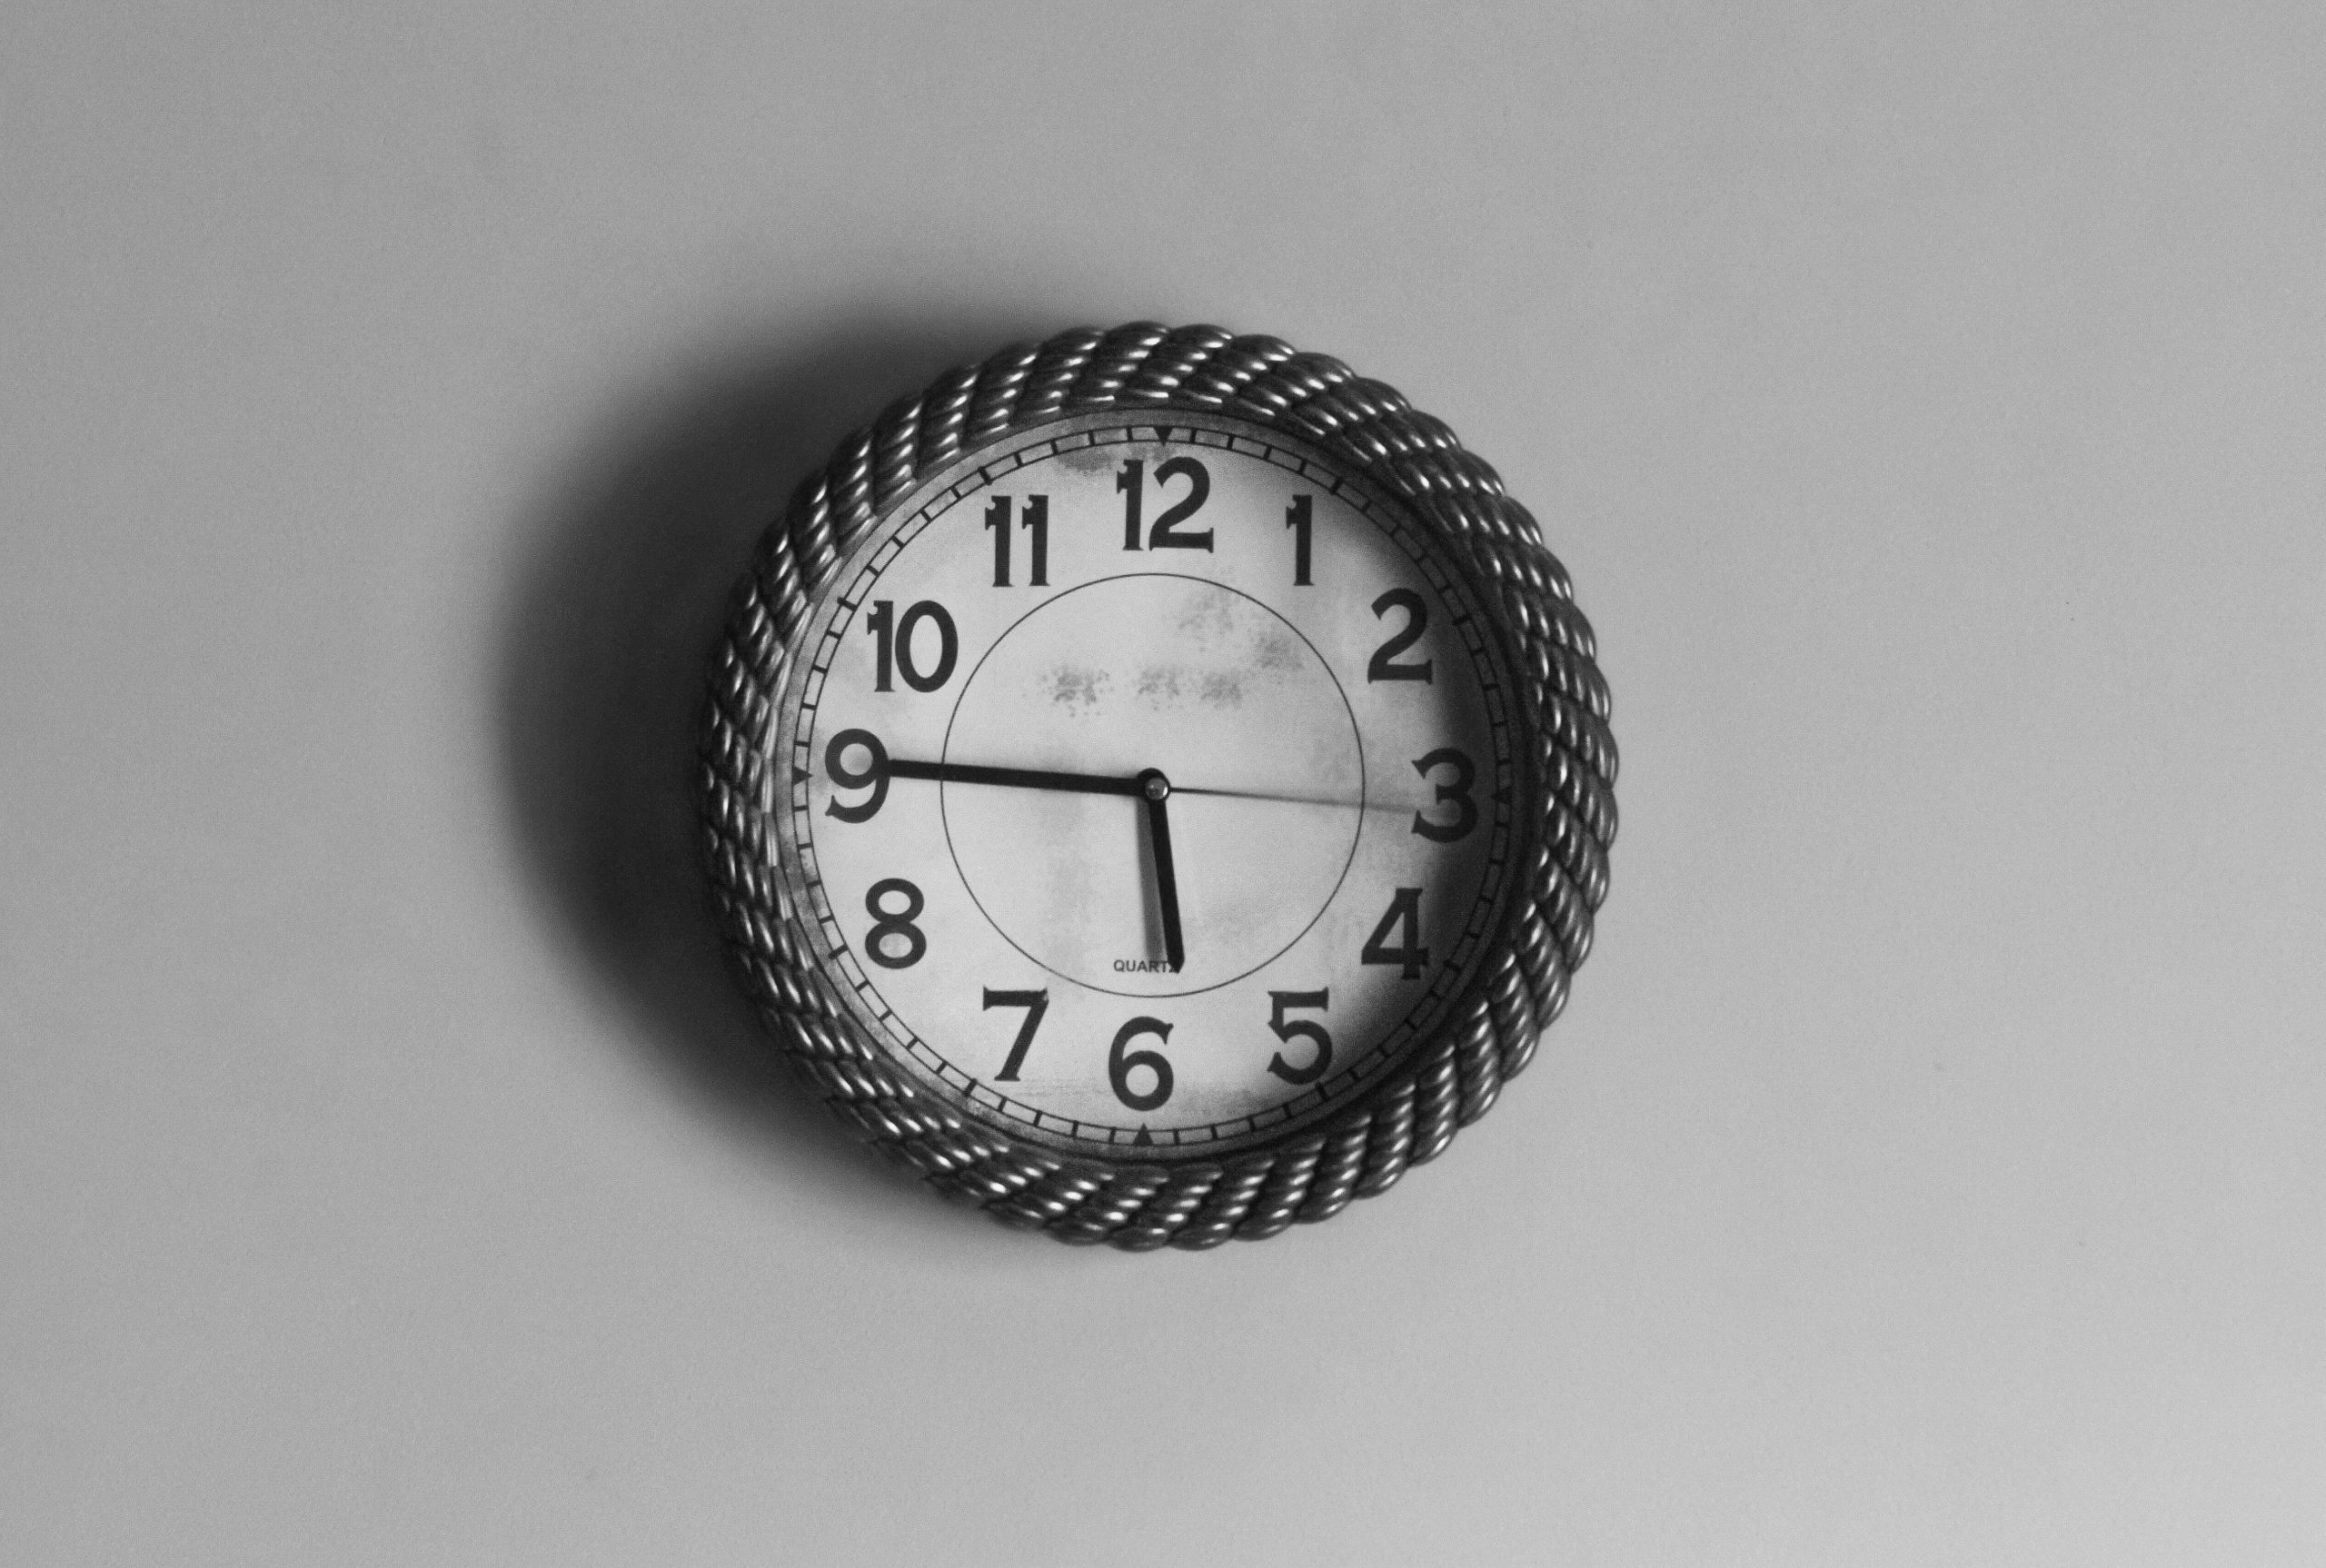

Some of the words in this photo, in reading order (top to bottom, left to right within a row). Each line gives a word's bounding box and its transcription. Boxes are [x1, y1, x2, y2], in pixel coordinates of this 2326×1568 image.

[985, 495, 1050, 587] 11
[1118, 457, 1215, 552] 12
[1287, 494, 1315, 586] 1
[867, 600, 959, 693] 10
[1368, 589, 1433, 684] 2
[825, 728, 890, 823] 9
[1412, 748, 1478, 843] 3
[864, 878, 927, 969] 8
[1361, 888, 1429, 980] 4
[983, 987, 1049, 1081] 7
[1108, 1017, 1174, 1111] 6
[1267, 987, 1333, 1085] 5
